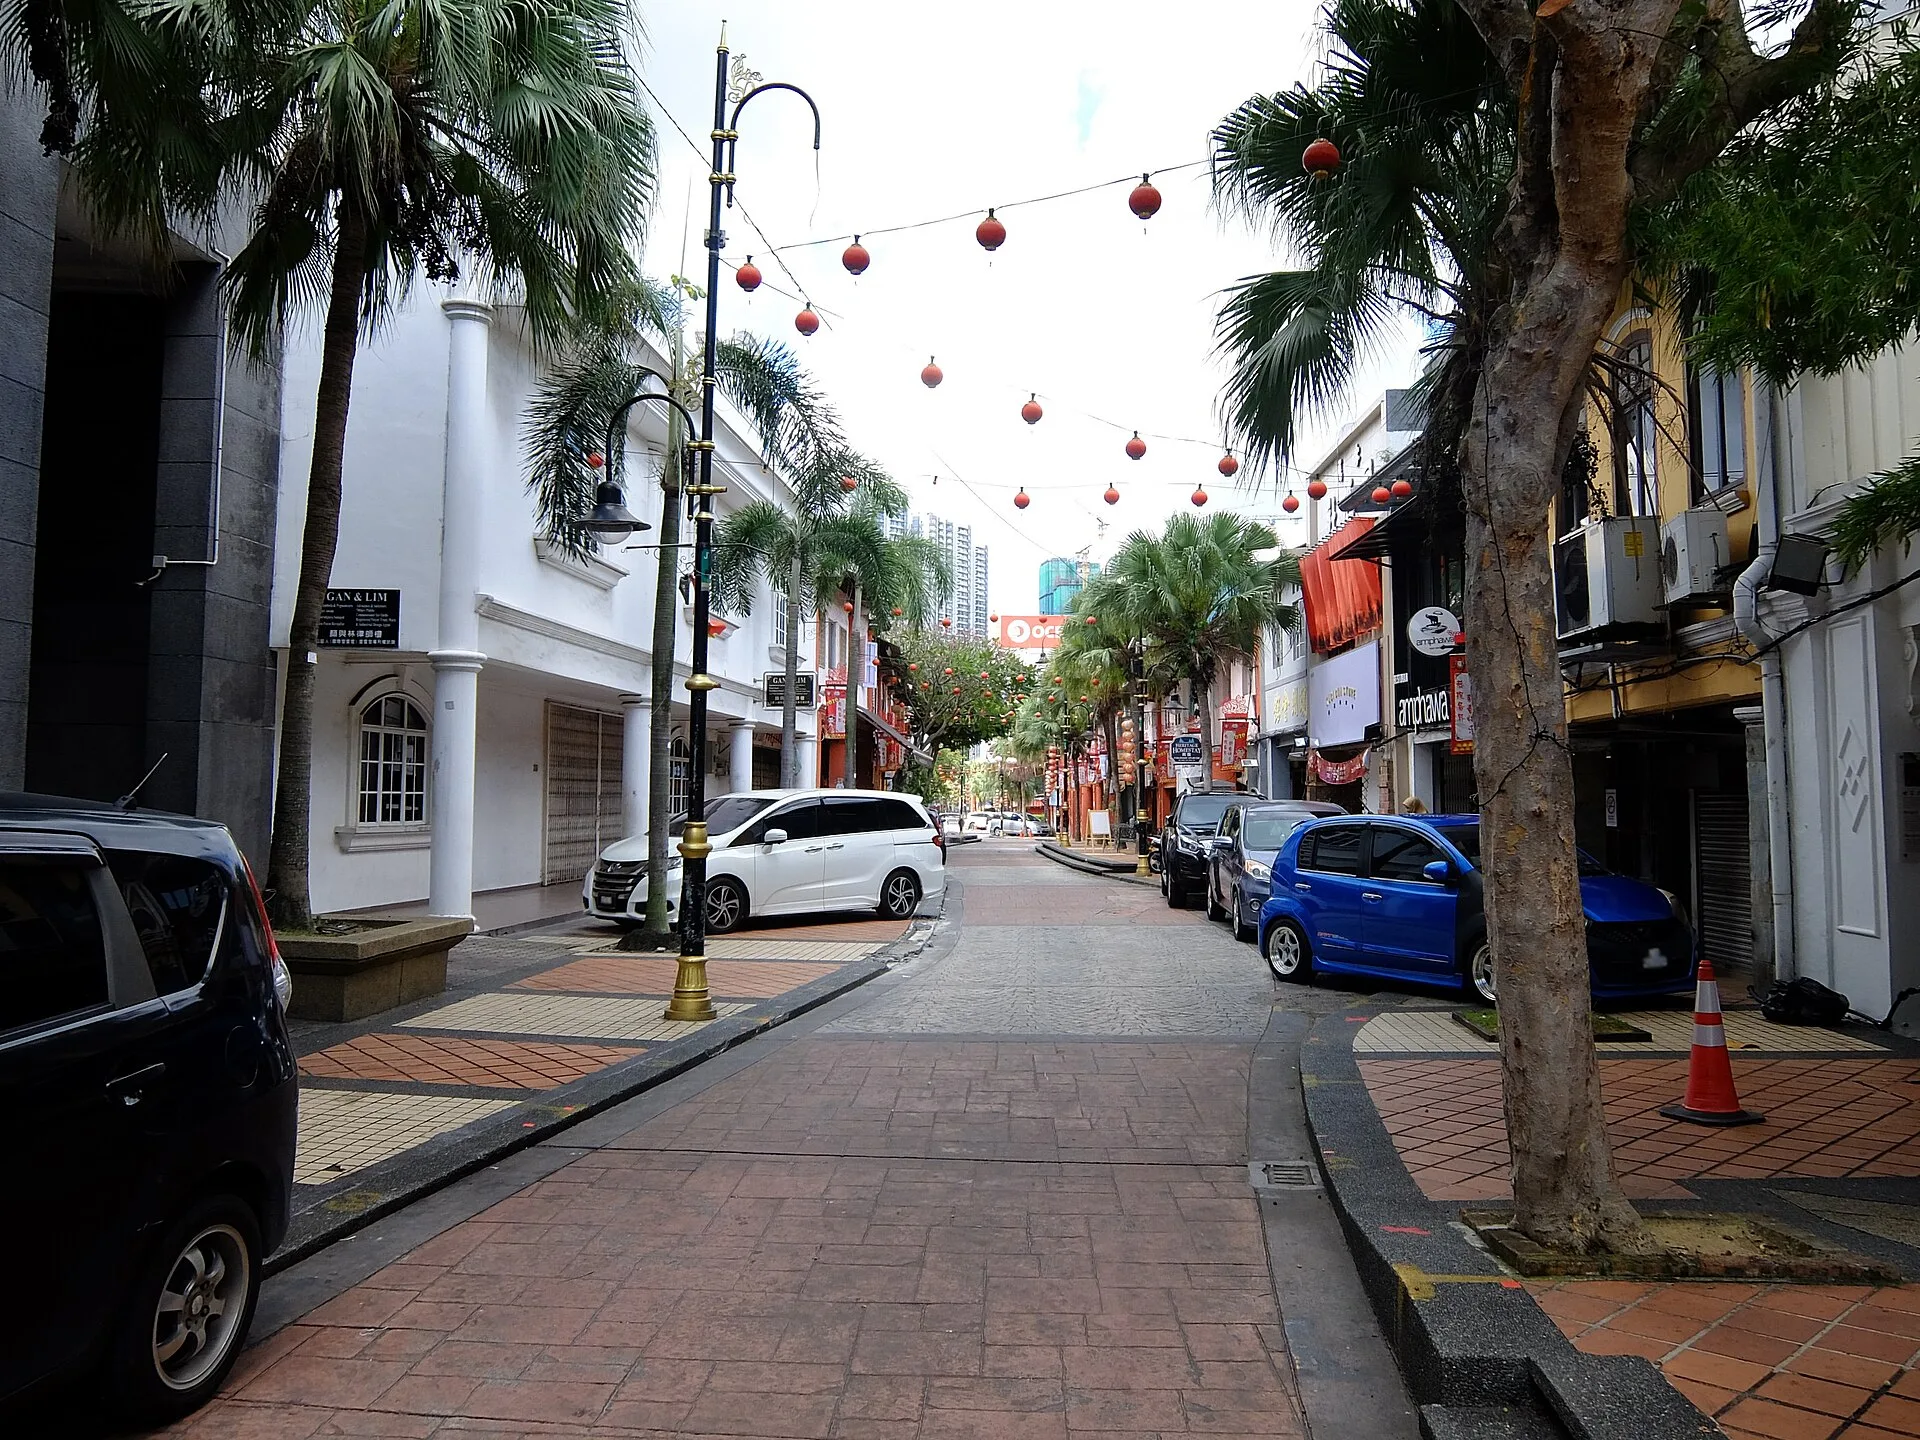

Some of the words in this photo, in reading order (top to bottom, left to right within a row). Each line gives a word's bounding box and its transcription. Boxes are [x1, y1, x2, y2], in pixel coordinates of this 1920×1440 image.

[326, 592, 351, 601] GAN
[353, 592, 362, 602] &
[365, 592, 387, 602] LIM
[1398, 686, 1450, 734] amphawa
